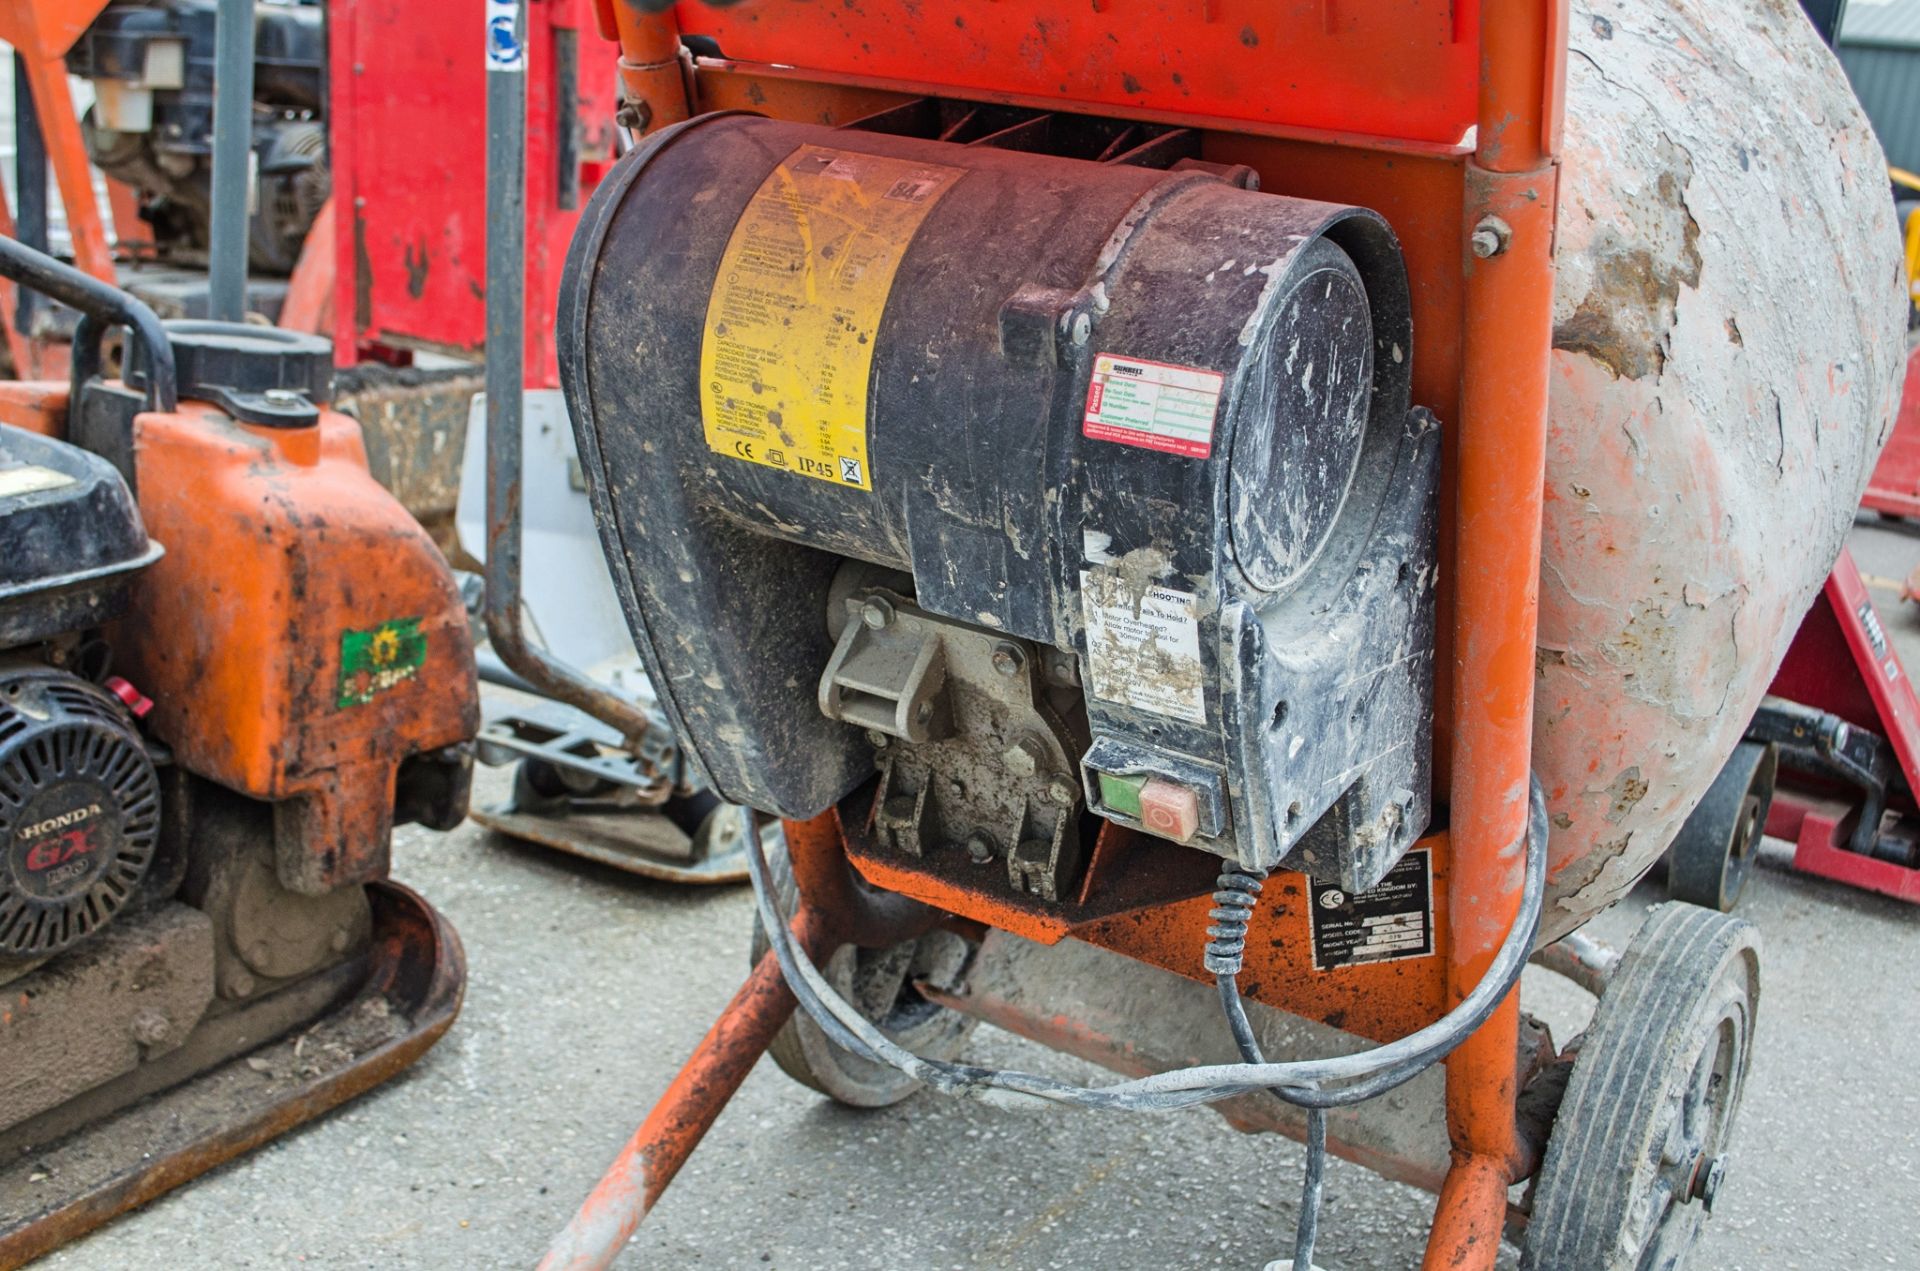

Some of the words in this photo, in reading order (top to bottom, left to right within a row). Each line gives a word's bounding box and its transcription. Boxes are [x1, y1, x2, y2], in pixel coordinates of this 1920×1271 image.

[1090, 386, 1101, 412] Passed
[798, 456, 834, 478] IP45
[1123, 616, 1168, 633] Overheated?
[1166, 613, 1188, 623] Hold?
[1123, 626, 1143, 635] motor
[1169, 635, 1179, 643] for
[23, 803, 101, 839] HONDA
[26, 823, 97, 871] GX
[1377, 884, 1406, 892] KINGDOM
[1321, 922, 1343, 930] SERIAL
